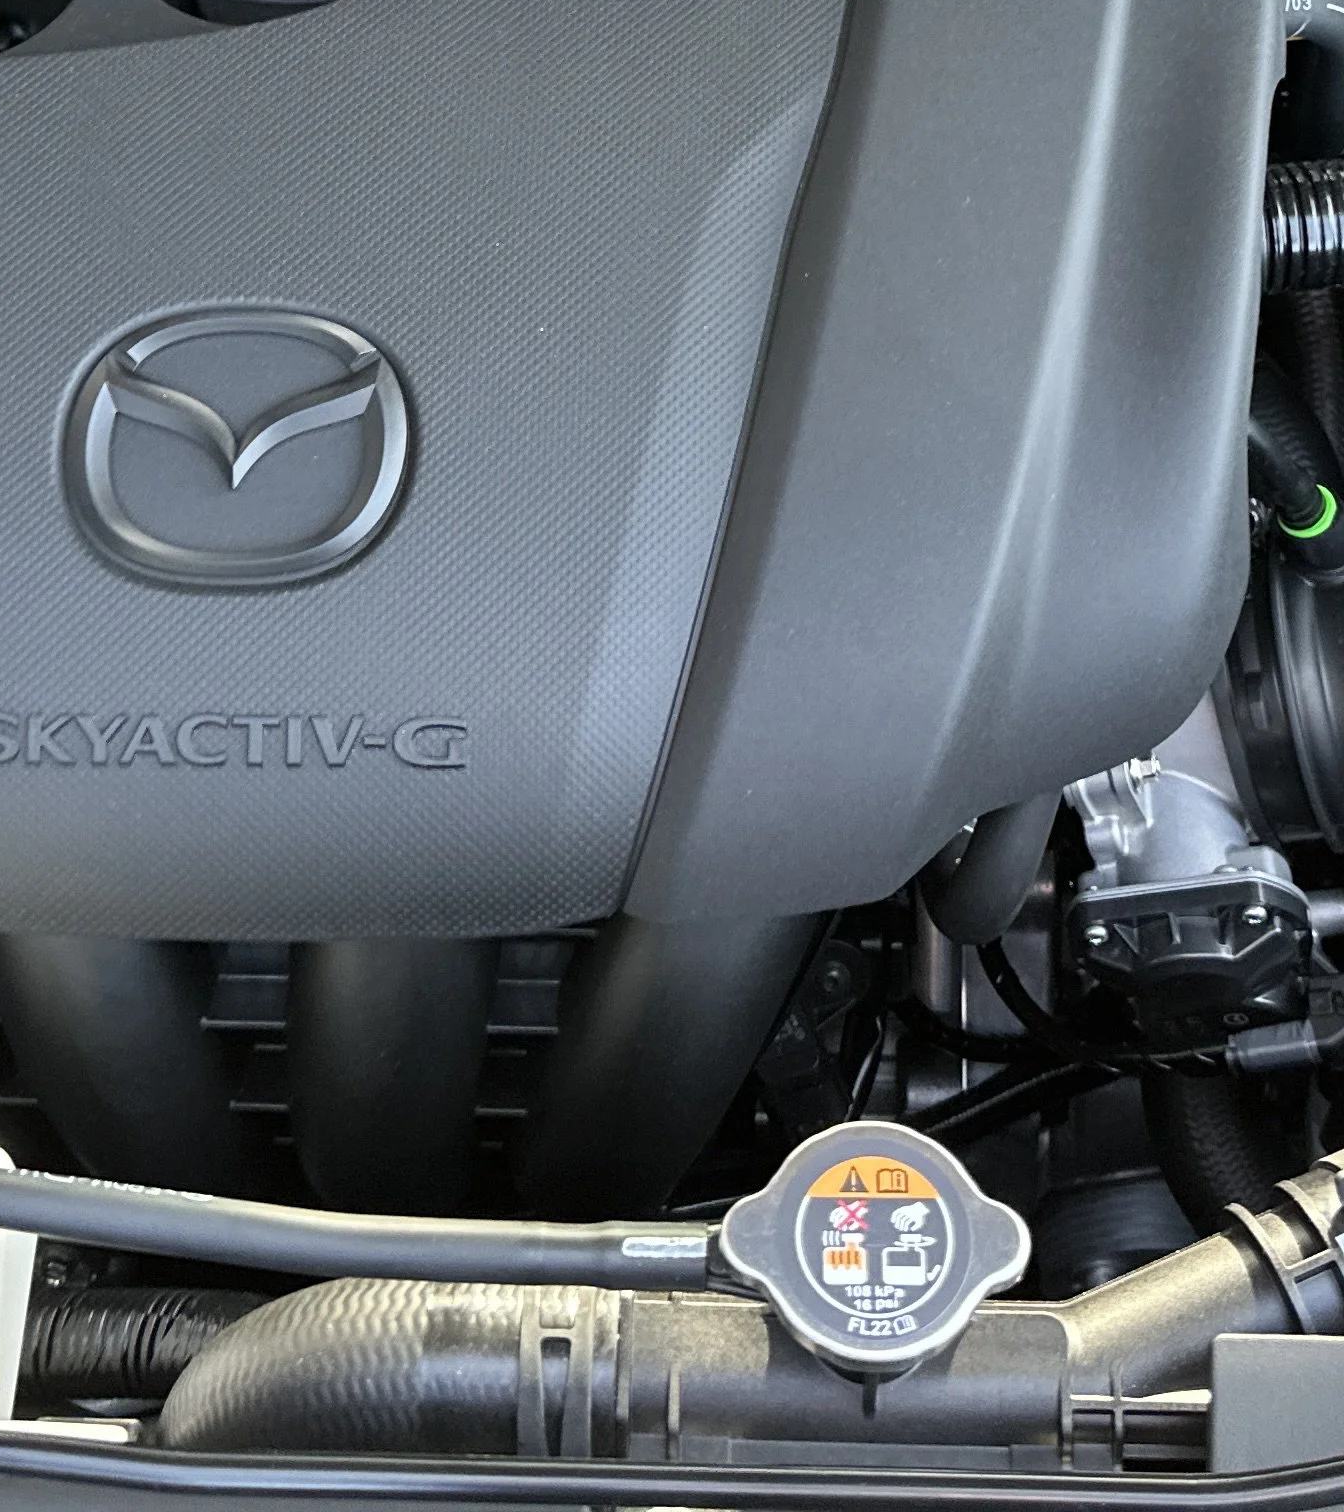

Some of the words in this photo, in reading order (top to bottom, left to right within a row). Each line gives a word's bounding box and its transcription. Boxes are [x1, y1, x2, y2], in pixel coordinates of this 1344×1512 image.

[844, 1285, 872, 1298] 108
[874, 1285, 906, 1299] kPa
[853, 1298, 872, 1311] 16
[875, 1298, 899, 1311] psi
[847, 1316, 893, 1336] FL22
